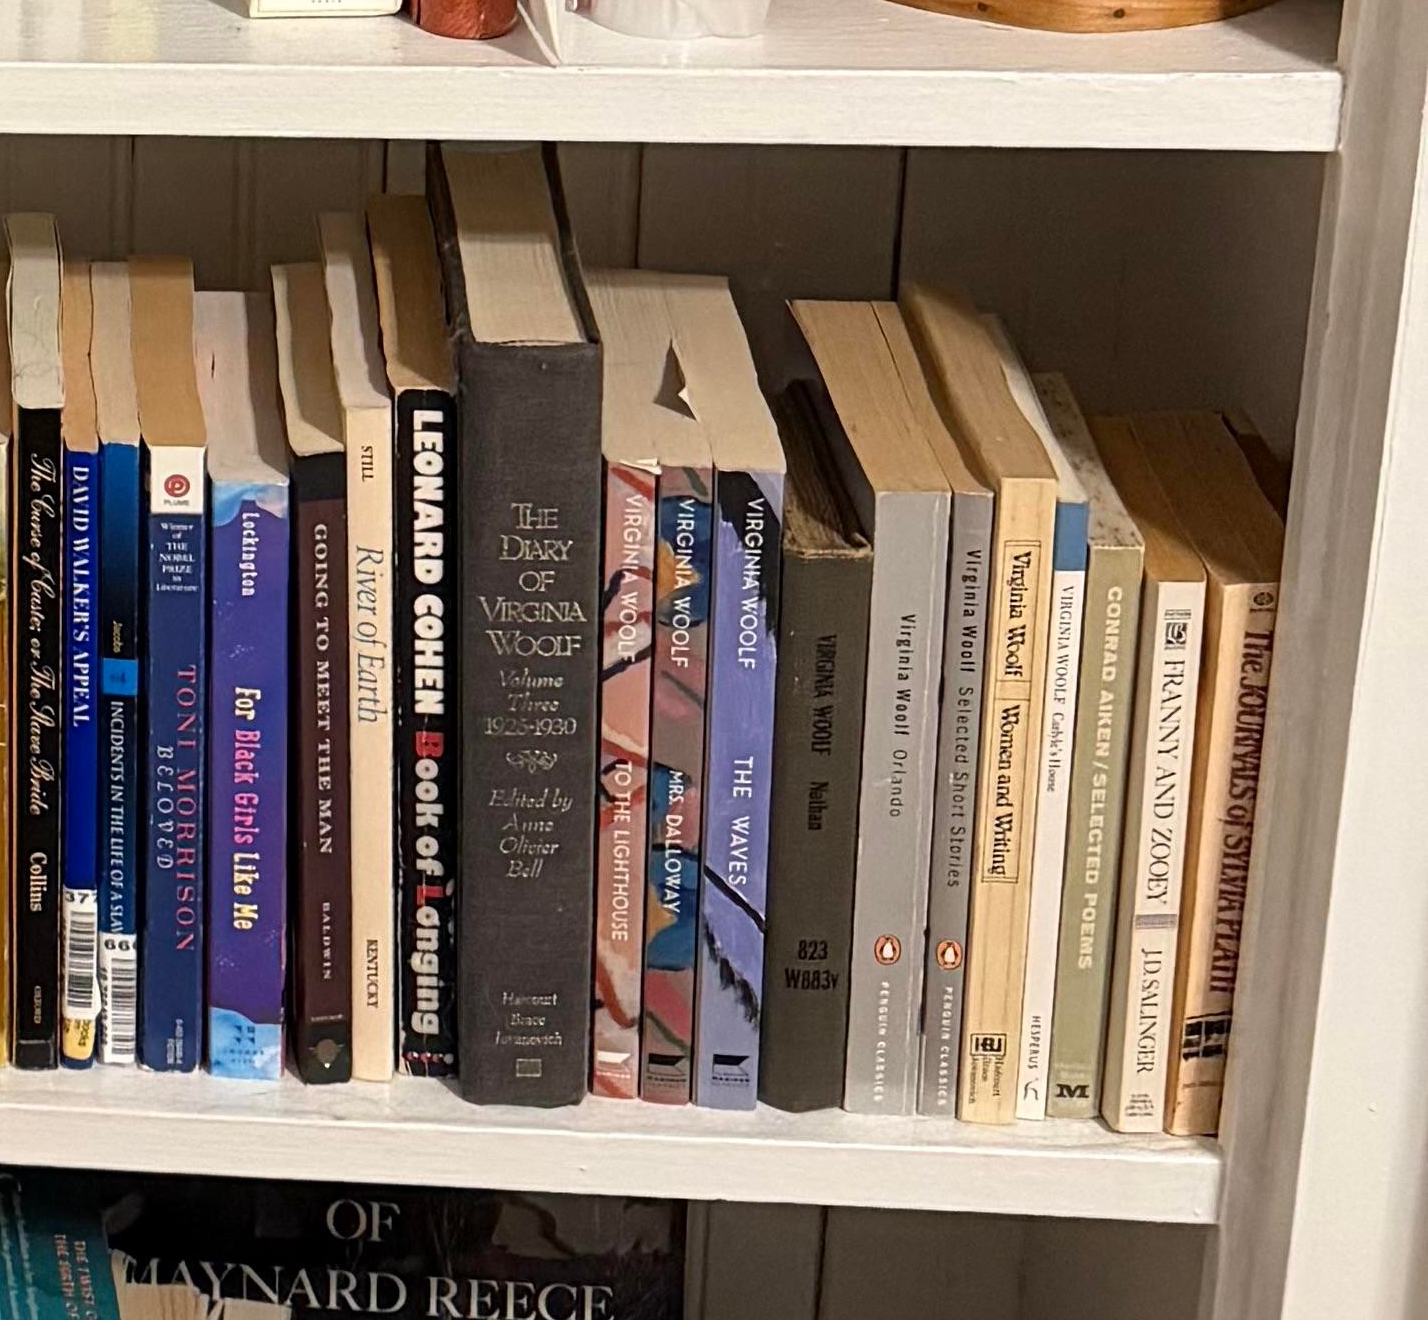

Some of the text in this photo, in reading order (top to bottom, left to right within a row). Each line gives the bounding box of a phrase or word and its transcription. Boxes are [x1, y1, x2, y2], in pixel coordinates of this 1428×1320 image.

[355, 545, 386, 724] River Earth
[412, 410, 445, 715] LEONARD COHEN
[313, 523, 333, 856] GOING MEET MAN
[1092, 585, 1123, 761] CONRAD AIKEN
[177, 665, 196, 952] TONI MORRISON
[889, 749, 906, 819] Orlando
[987, 705, 1021, 878] Women Writing
[1146, 659, 1186, 905] FRANNY ZOOEY
[321, 902, 333, 981] BALDWIN
[365, 938, 379, 1009] KENTUCKY
[1135, 979, 1161, 1074] SALINGER
